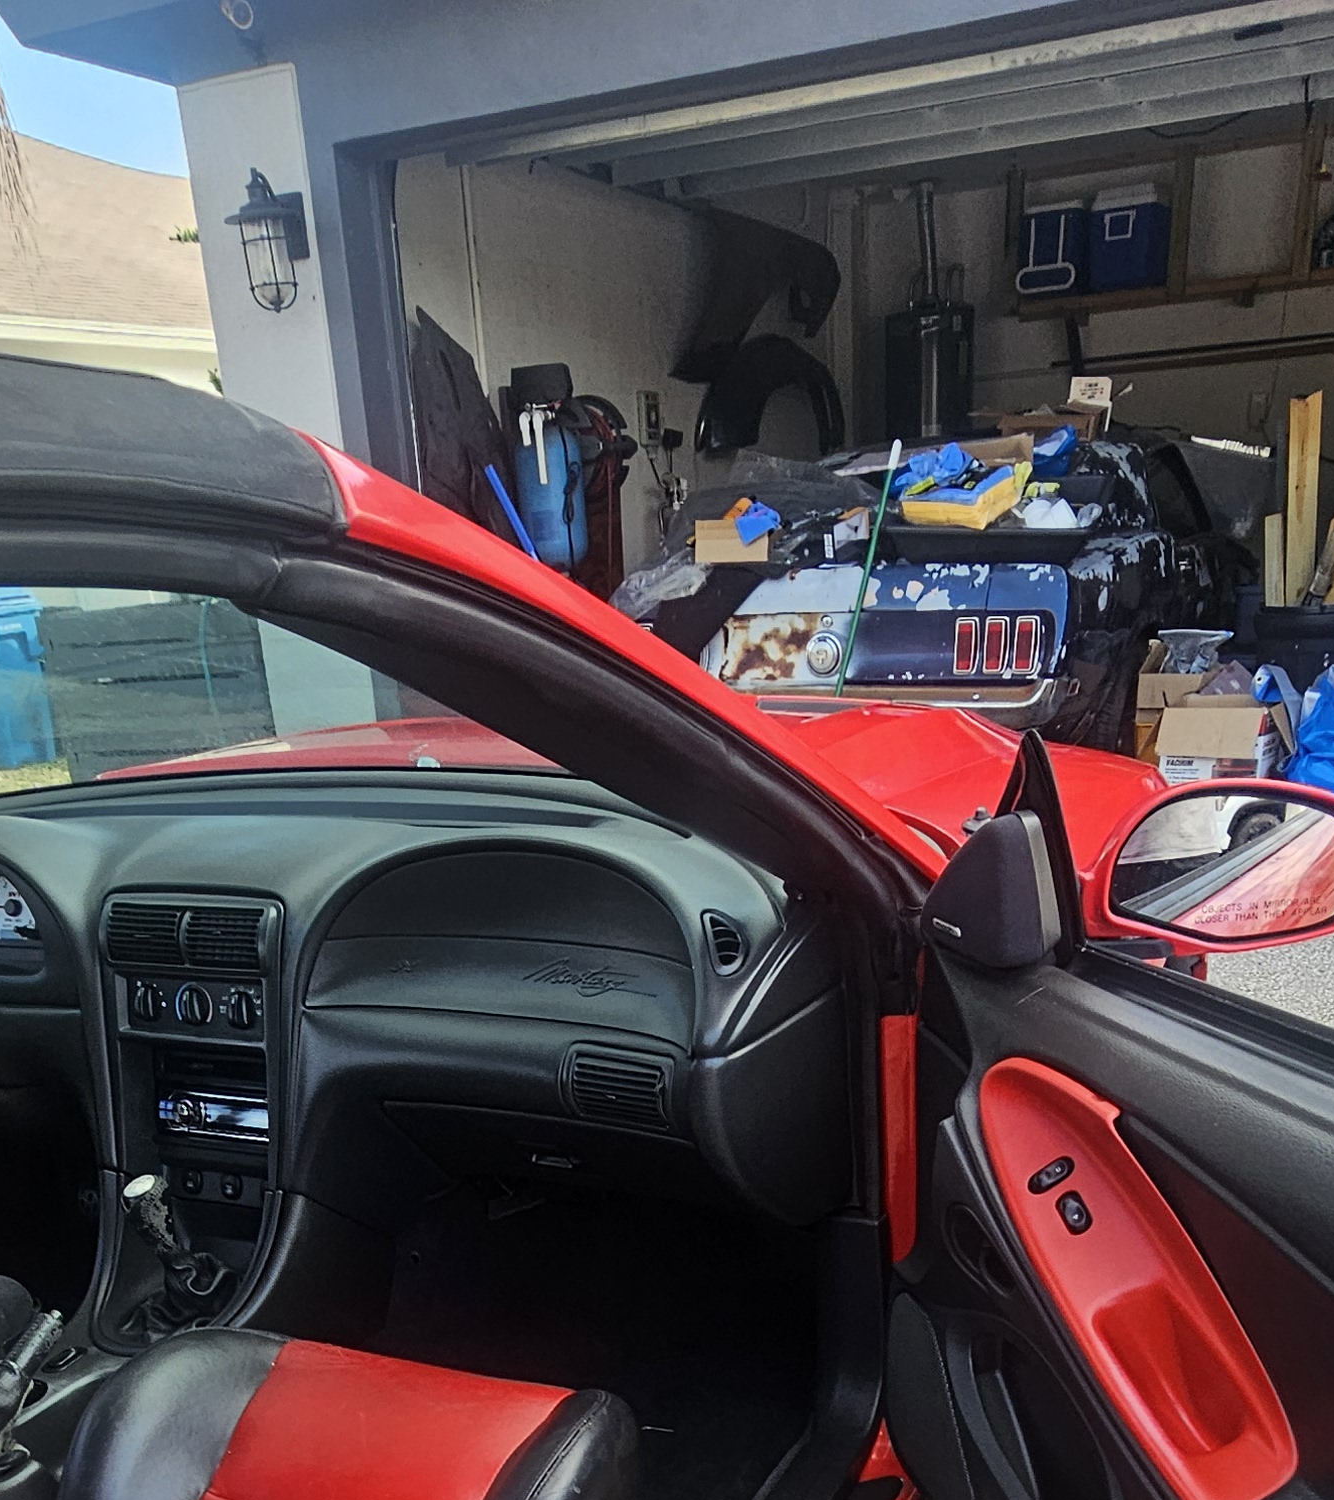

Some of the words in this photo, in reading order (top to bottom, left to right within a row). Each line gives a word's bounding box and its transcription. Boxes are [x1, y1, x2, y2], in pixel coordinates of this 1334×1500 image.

[1201, 903, 1243, 914] OBJECTS
[1249, 901, 1259, 910] IN
[1264, 898, 1299, 909] MIRROR
[1301, 895, 1322, 905] ARE
[1194, 914, 1229, 925] CLOSER
[1235, 912, 1259, 921] THAN
[1263, 909, 1287, 919] THEY
[1291, 906, 1328, 917] APPEAR
